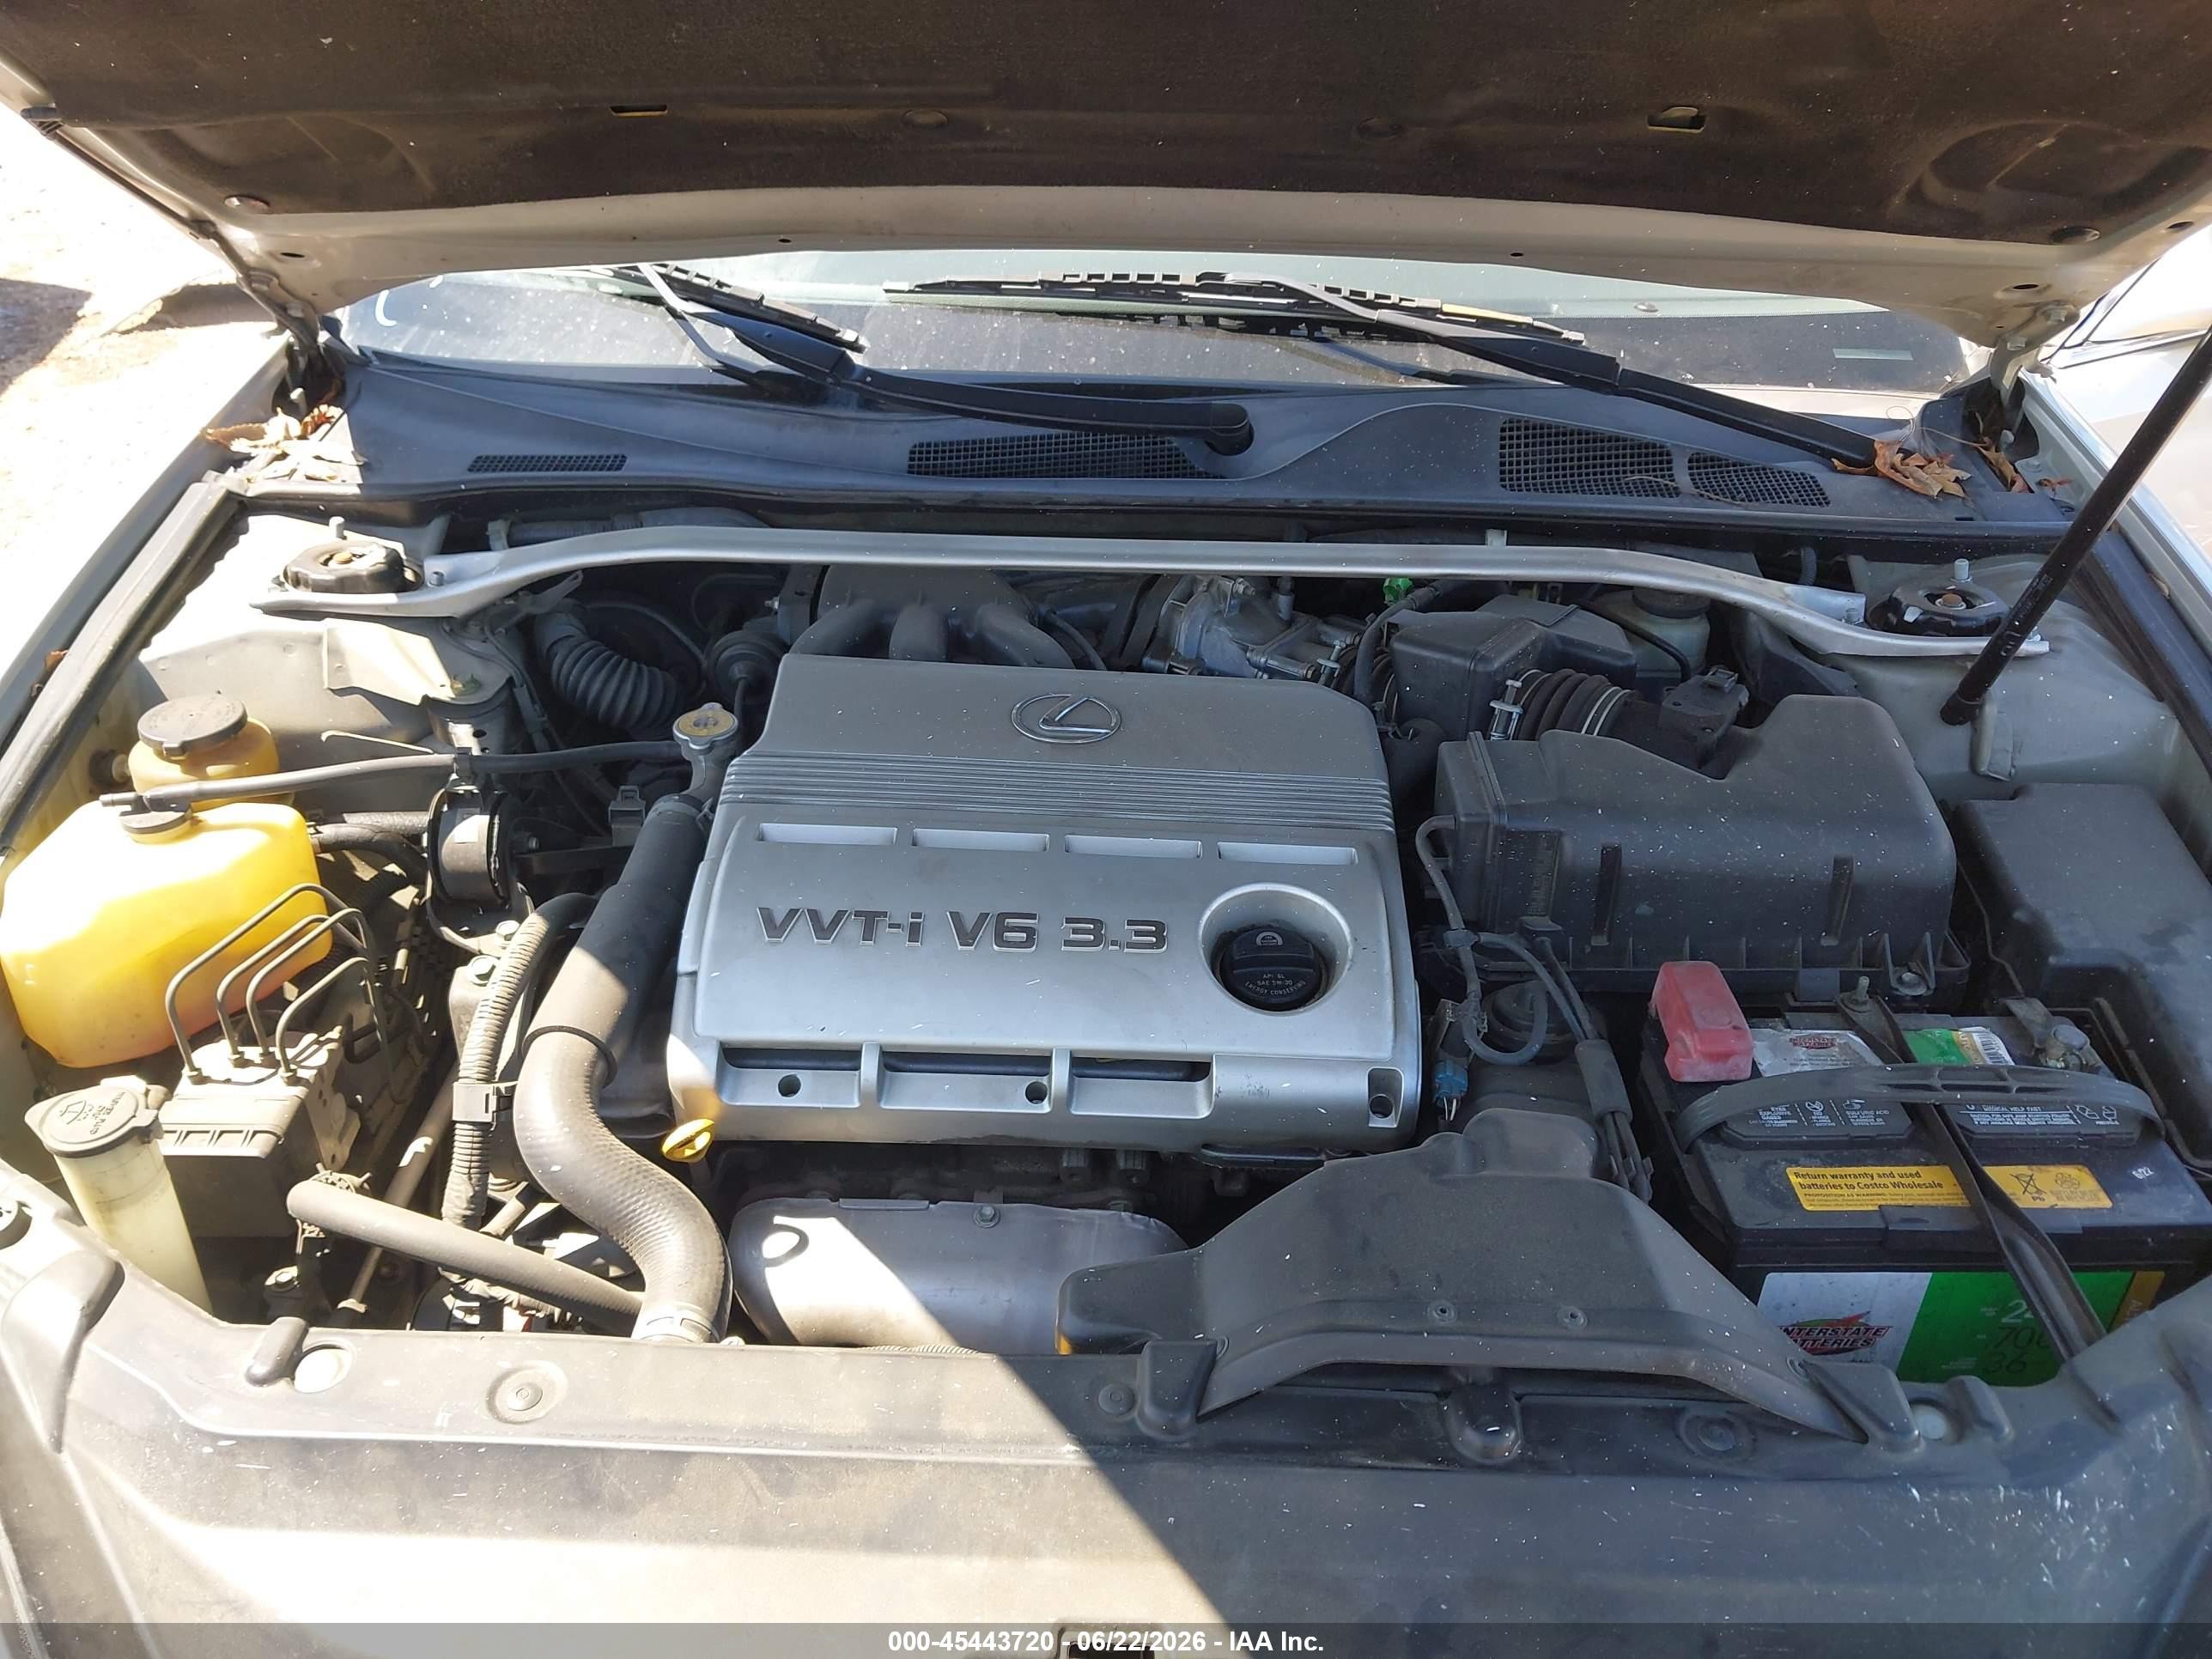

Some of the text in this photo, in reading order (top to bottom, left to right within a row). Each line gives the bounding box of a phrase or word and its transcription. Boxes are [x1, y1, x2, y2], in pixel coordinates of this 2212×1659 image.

[756, 907, 1168, 954] VVT-i V6 3.3
[1794, 1171, 1829, 1181] Return
[1830, 1172, 1875, 1182] warranty
[1799, 1181, 1844, 1190] batteries
[1856, 1182, 1890, 1190] Costco
[1891, 1181, 1944, 1189] Wholesale
[1792, 1338, 1874, 1347] TTERIES
